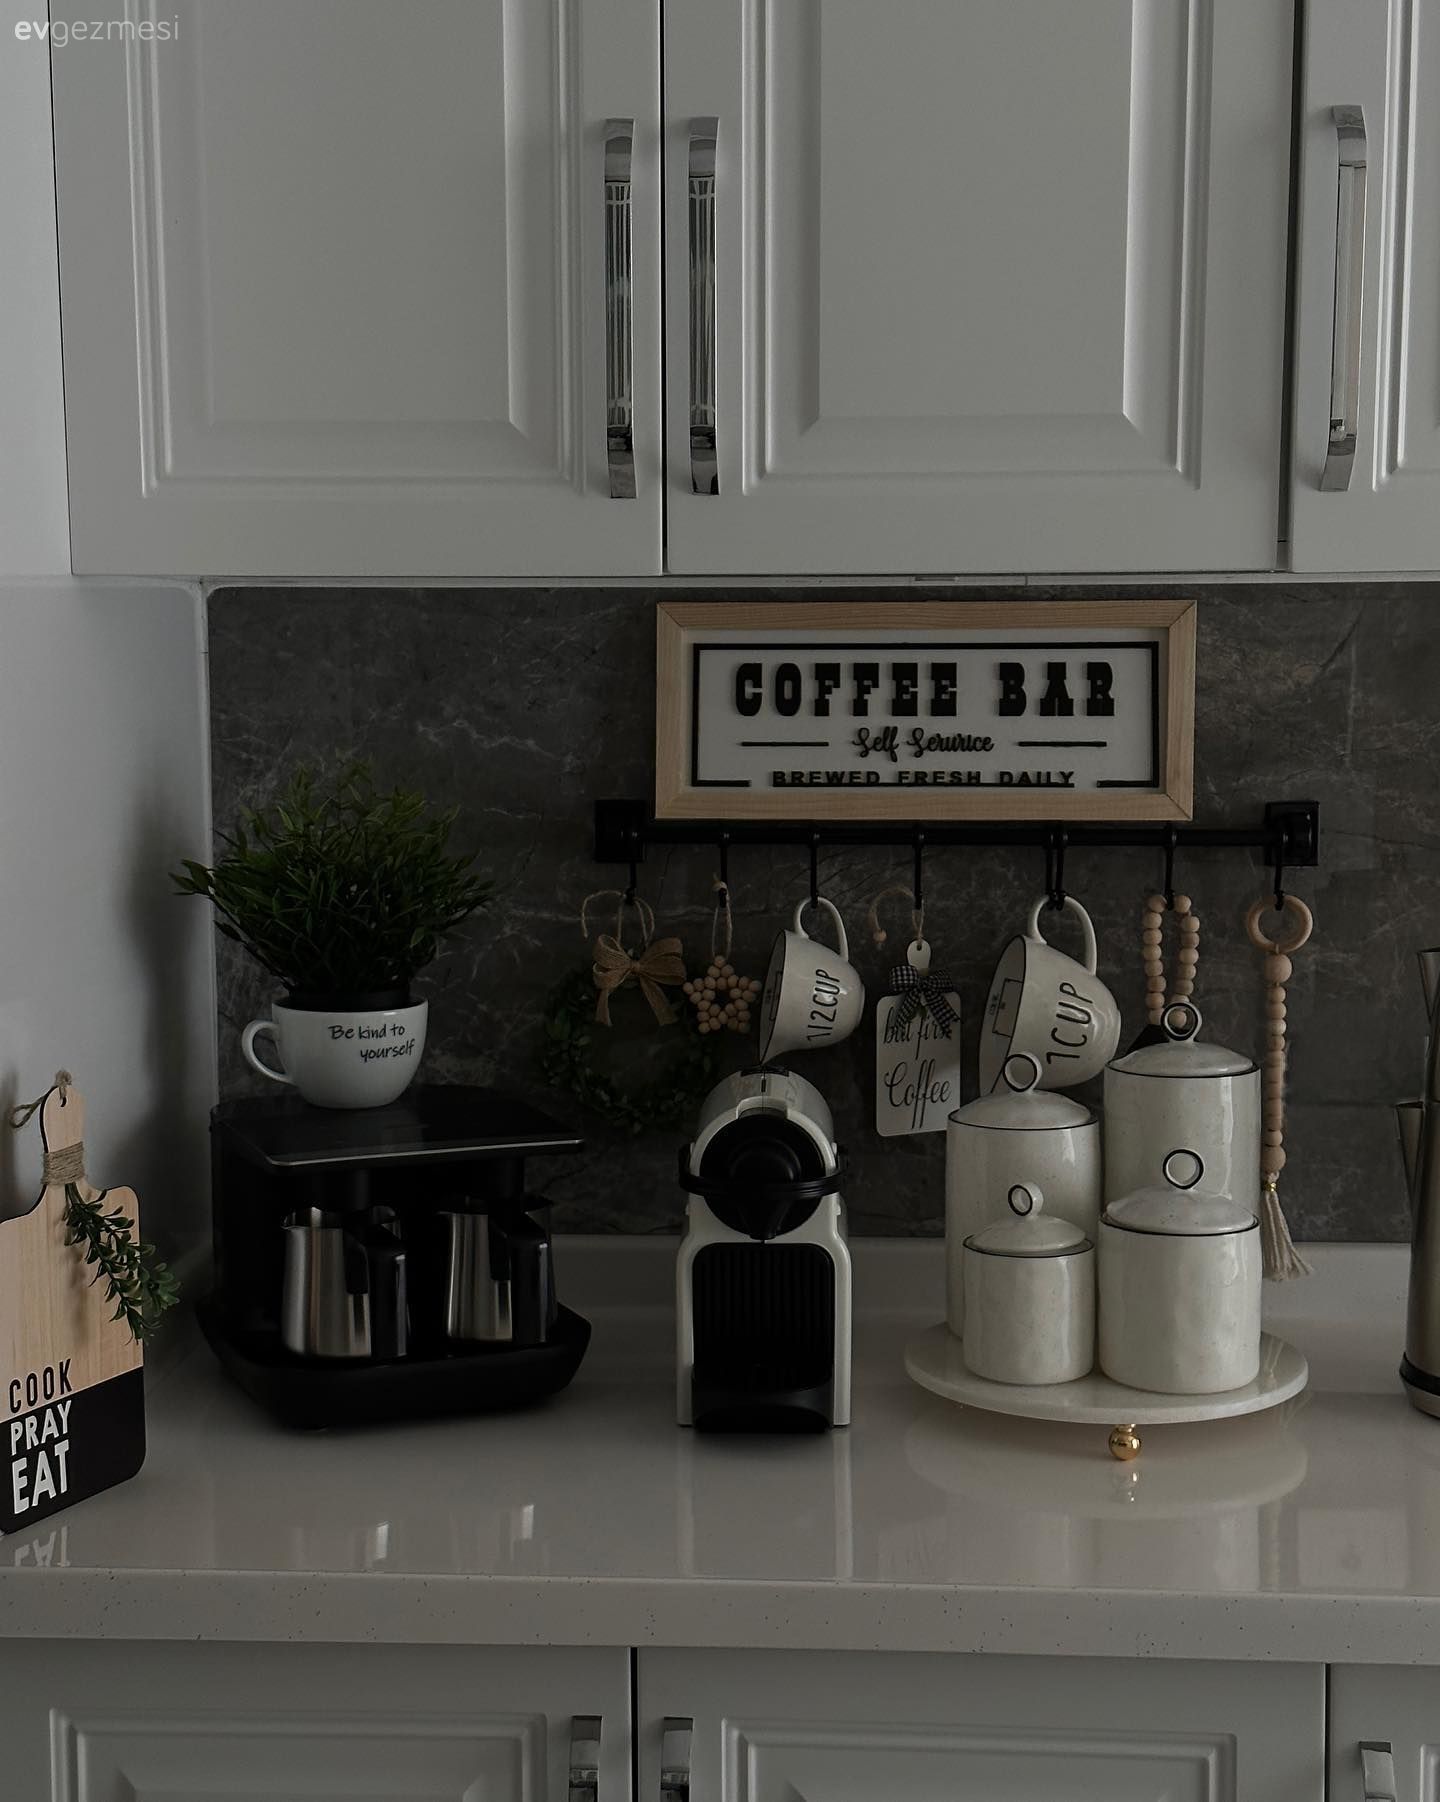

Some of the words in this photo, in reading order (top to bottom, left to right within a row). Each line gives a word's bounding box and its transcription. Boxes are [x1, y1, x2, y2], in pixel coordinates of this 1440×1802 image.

[735, 662, 957, 717] COFFEE
[999, 662, 1115, 717] BAR
[852, 726, 899, 763] Self
[906, 727, 995, 758] Service
[773, 770, 880, 786] BREWED
[898, 770, 981, 786] FRESH
[1000, 770, 1075, 786] DAILY
[328, 1024, 354, 1040] Be
[358, 1024, 387, 1040] kind
[389, 1024, 405, 1036] to
[359, 1038, 415, 1062] yourself
[884, 1058, 952, 1130] Coffee
[9, 1358, 73, 1414] COOK
[10, 1399, 73, 1457] PRAY
[11, 1439, 70, 1516] EAT
